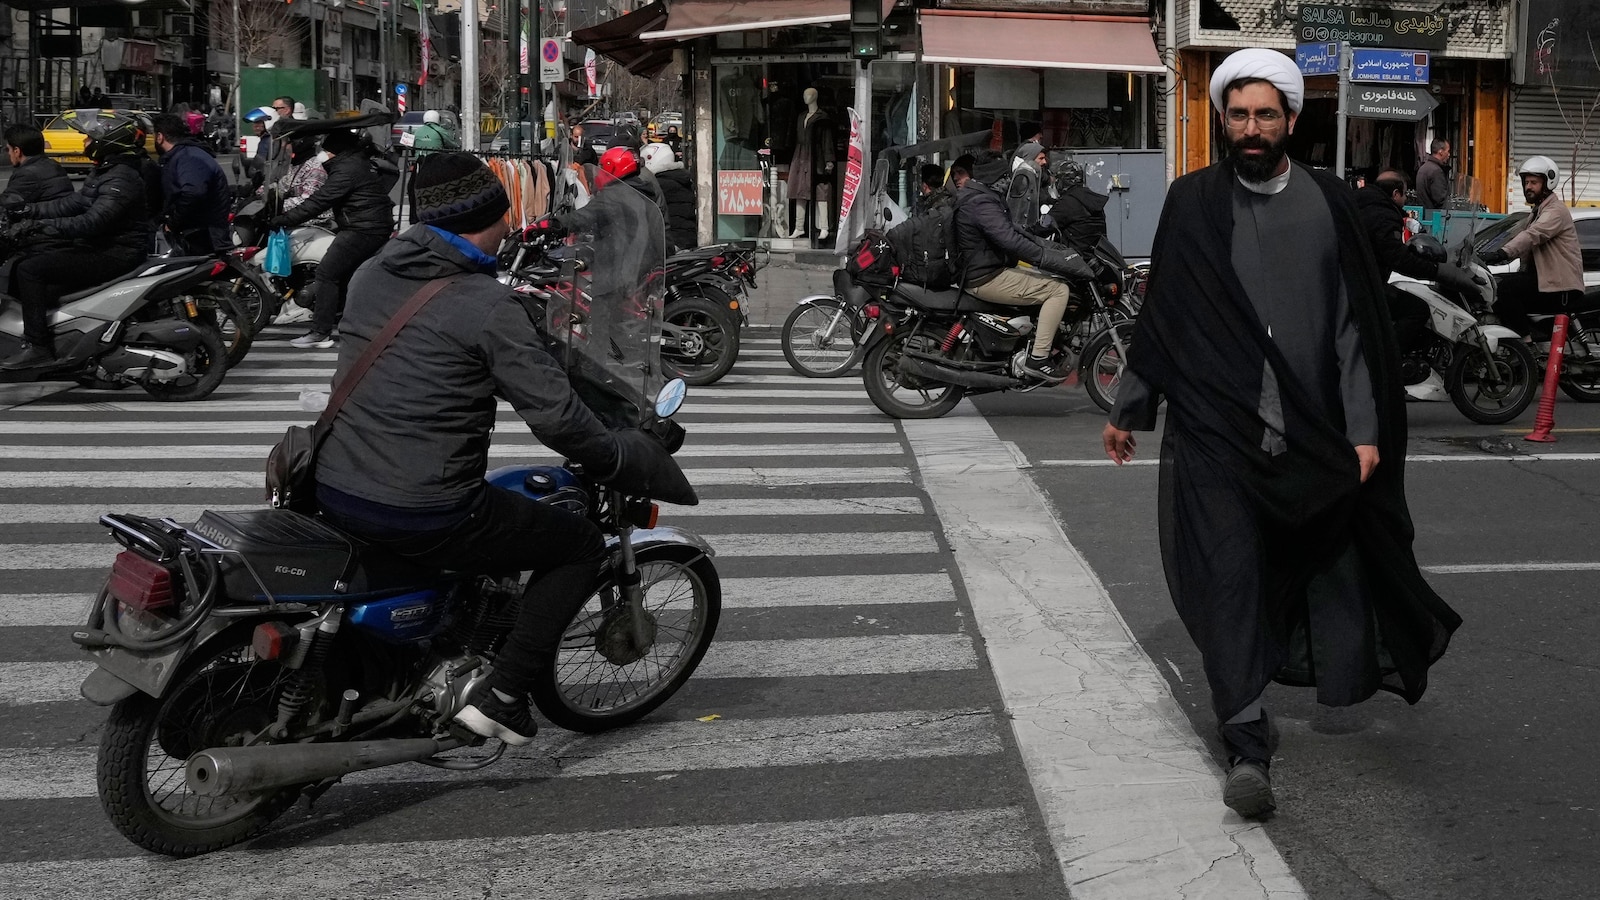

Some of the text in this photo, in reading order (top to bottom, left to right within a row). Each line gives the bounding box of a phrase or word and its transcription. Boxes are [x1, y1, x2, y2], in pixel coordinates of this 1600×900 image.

[1302, 7, 1345, 24] SALSA
[1350, 10, 1444, 36] تولیدی سالسا
[1329, 28, 1384, 44] @salsagroup
[1304, 51, 1327, 67] ولیعصر
[1357, 59, 1410, 70] جمهوری اسلامی
[1359, 104, 1417, 116] Famouri House
[720, 189, 761, 212] ۴۸۵۰۰۰
[193, 520, 233, 547] RAHRO
[274, 565, 307, 578] KG-CDI
